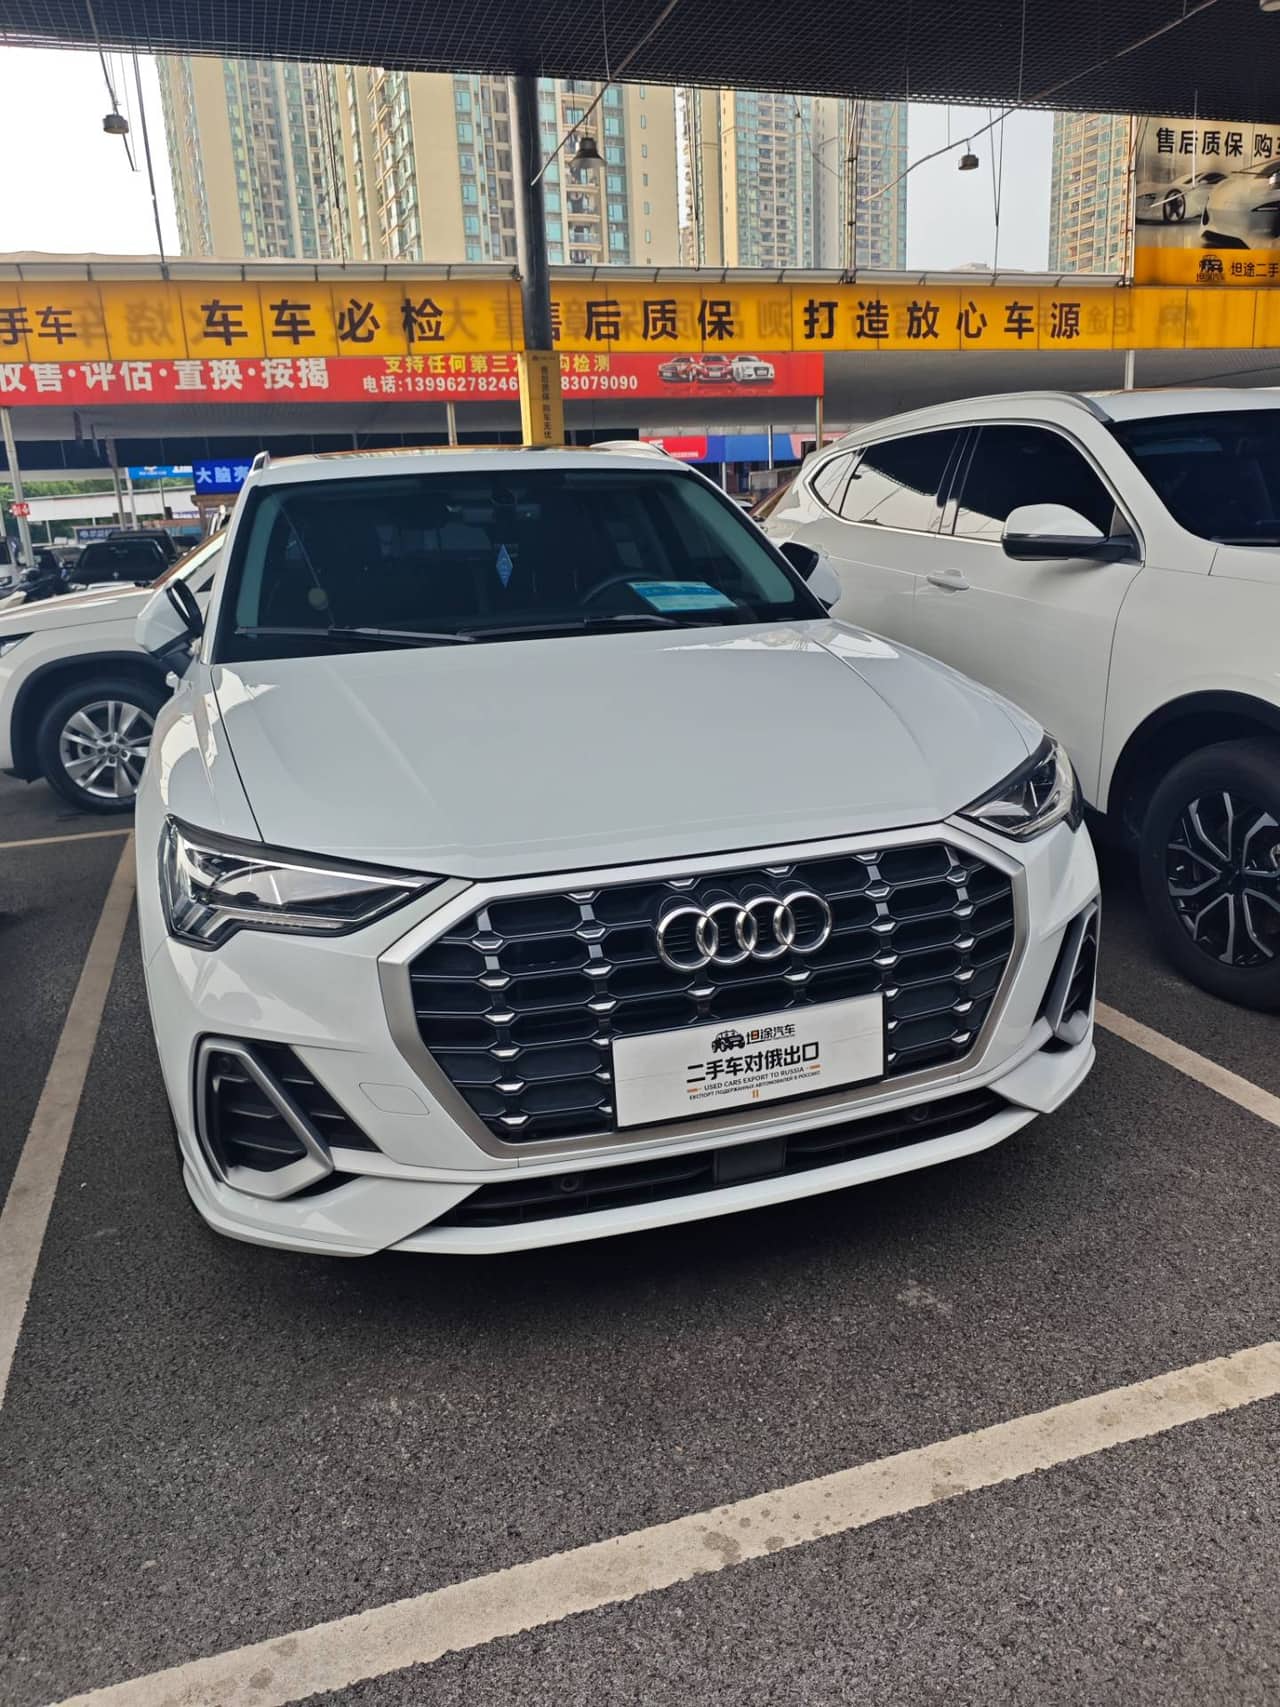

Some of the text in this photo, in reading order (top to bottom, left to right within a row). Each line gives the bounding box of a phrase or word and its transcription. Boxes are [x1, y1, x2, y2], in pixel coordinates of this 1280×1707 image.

[1156, 127, 1280, 158] 售后质保 购
[201, 298, 445, 346] 车车必检
[803, 299, 1081, 341] 打造放心车源
[687, 1041, 819, 1083] 二手车对俄出口
[704, 1066, 804, 1091] USED CARS EXPORT TO RUSSIA
